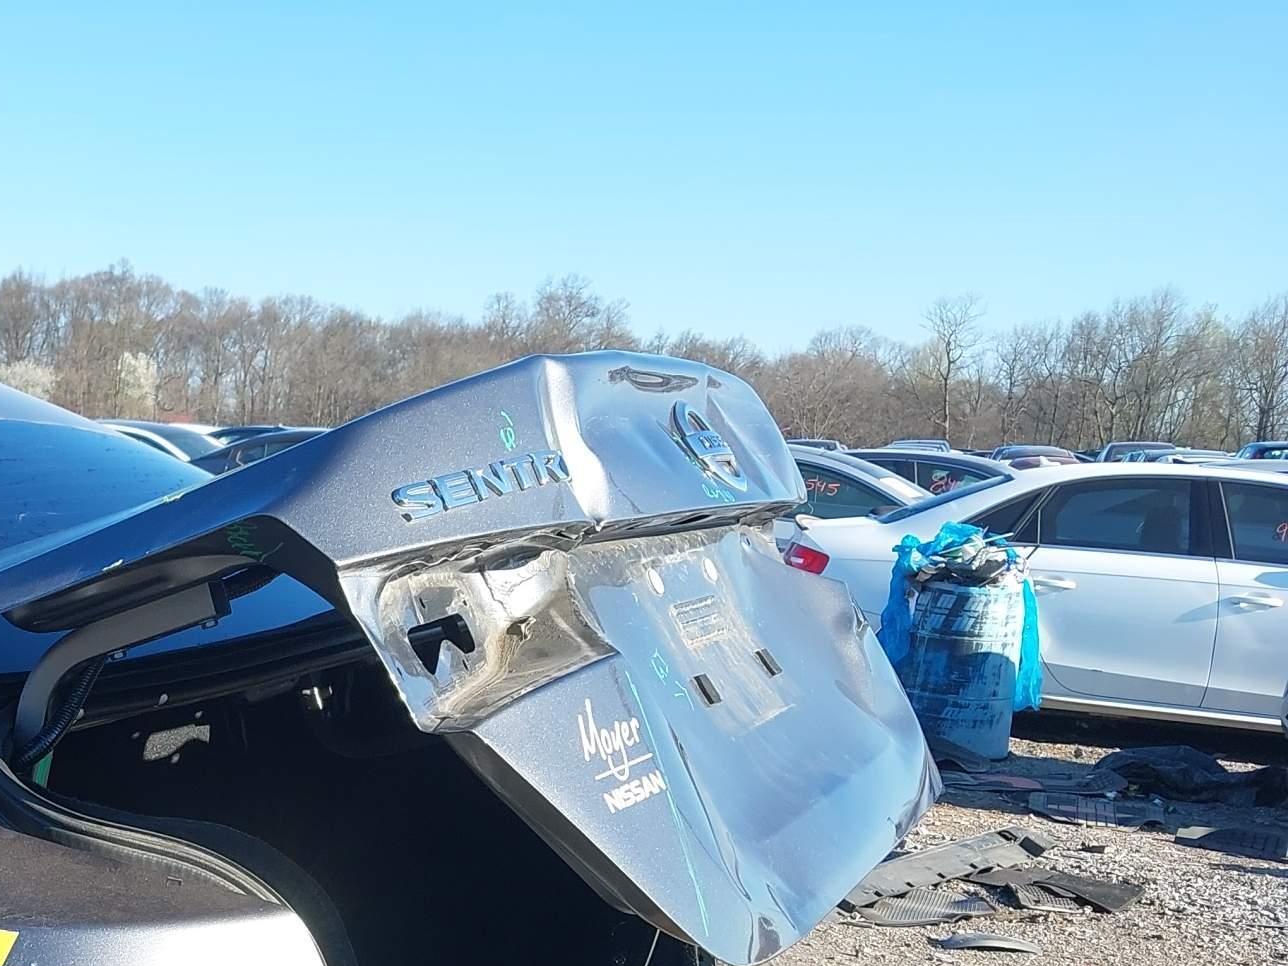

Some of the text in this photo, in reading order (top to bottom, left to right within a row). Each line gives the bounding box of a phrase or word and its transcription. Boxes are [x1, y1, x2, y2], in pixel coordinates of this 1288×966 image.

[390, 449, 572, 523] SENTR
[576, 697, 642, 781] Moyer
[602, 769, 668, 814] NISSAN
